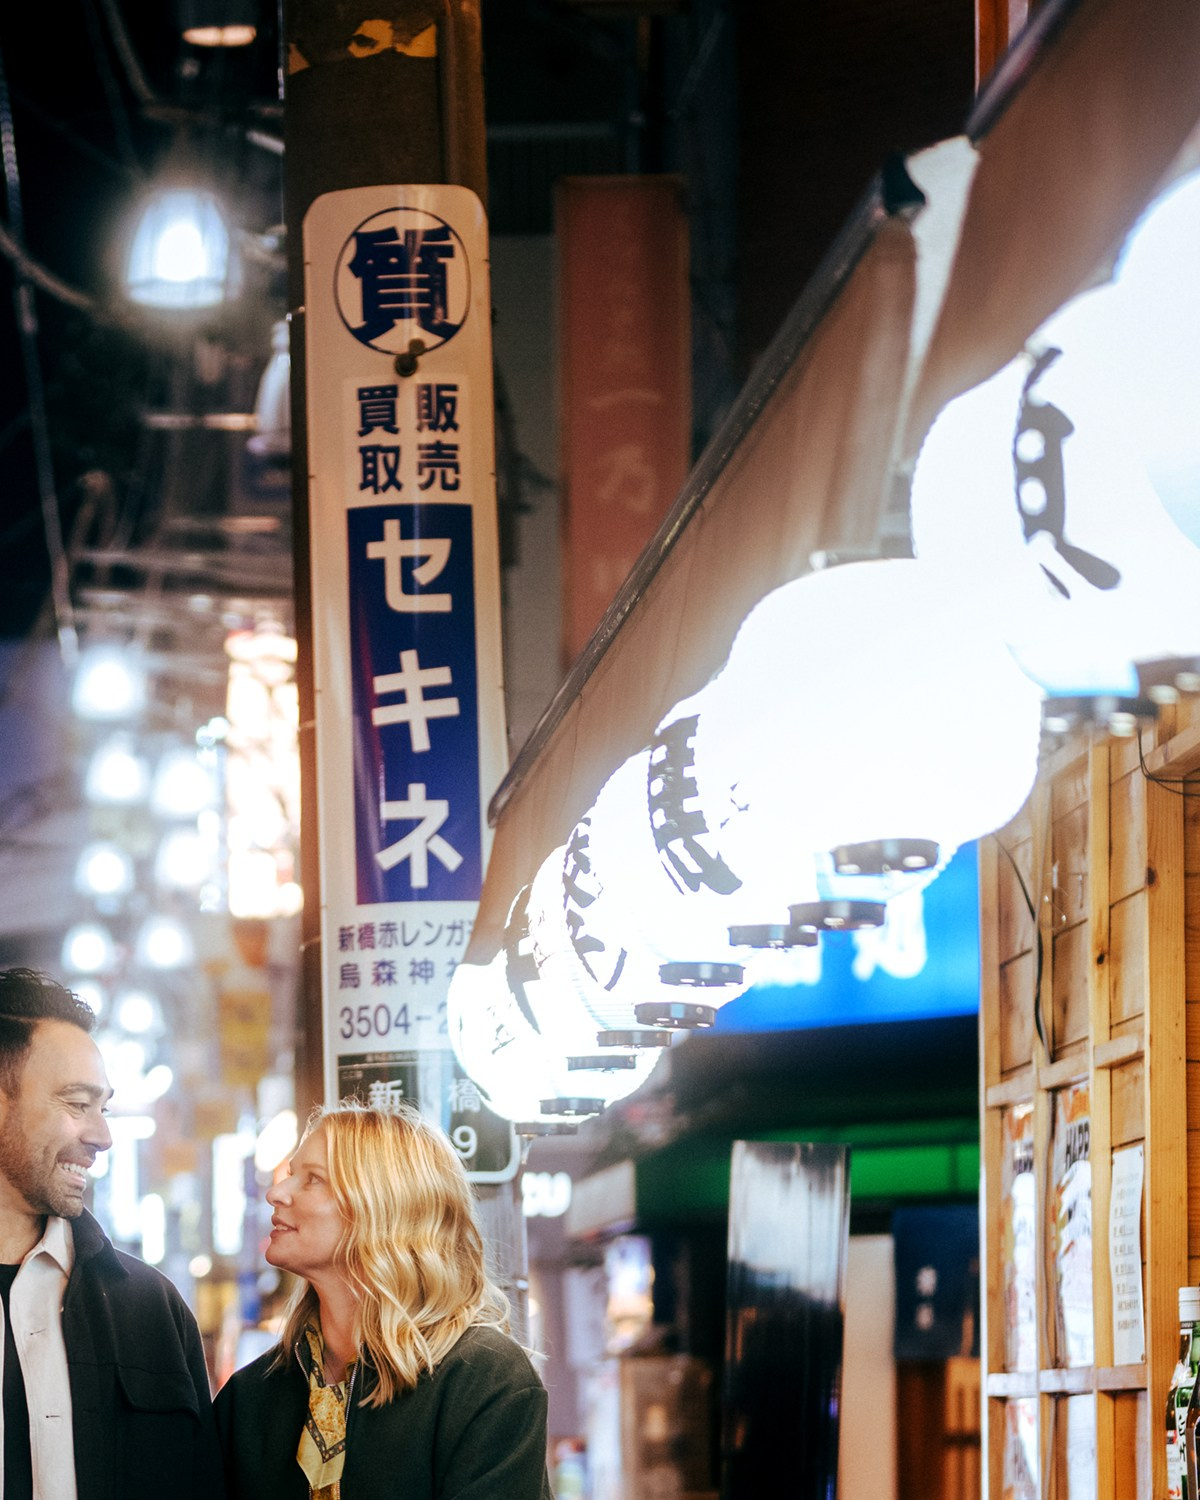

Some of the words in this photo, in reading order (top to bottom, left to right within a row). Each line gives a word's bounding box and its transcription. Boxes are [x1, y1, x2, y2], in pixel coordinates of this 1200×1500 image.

[347, 225, 459, 345] 質
[357, 385, 403, 494] 買取
[415, 383, 461, 492] 販売
[366, 519, 464, 889] セキネ
[338, 921, 473, 951] 新橋赤レンガ
